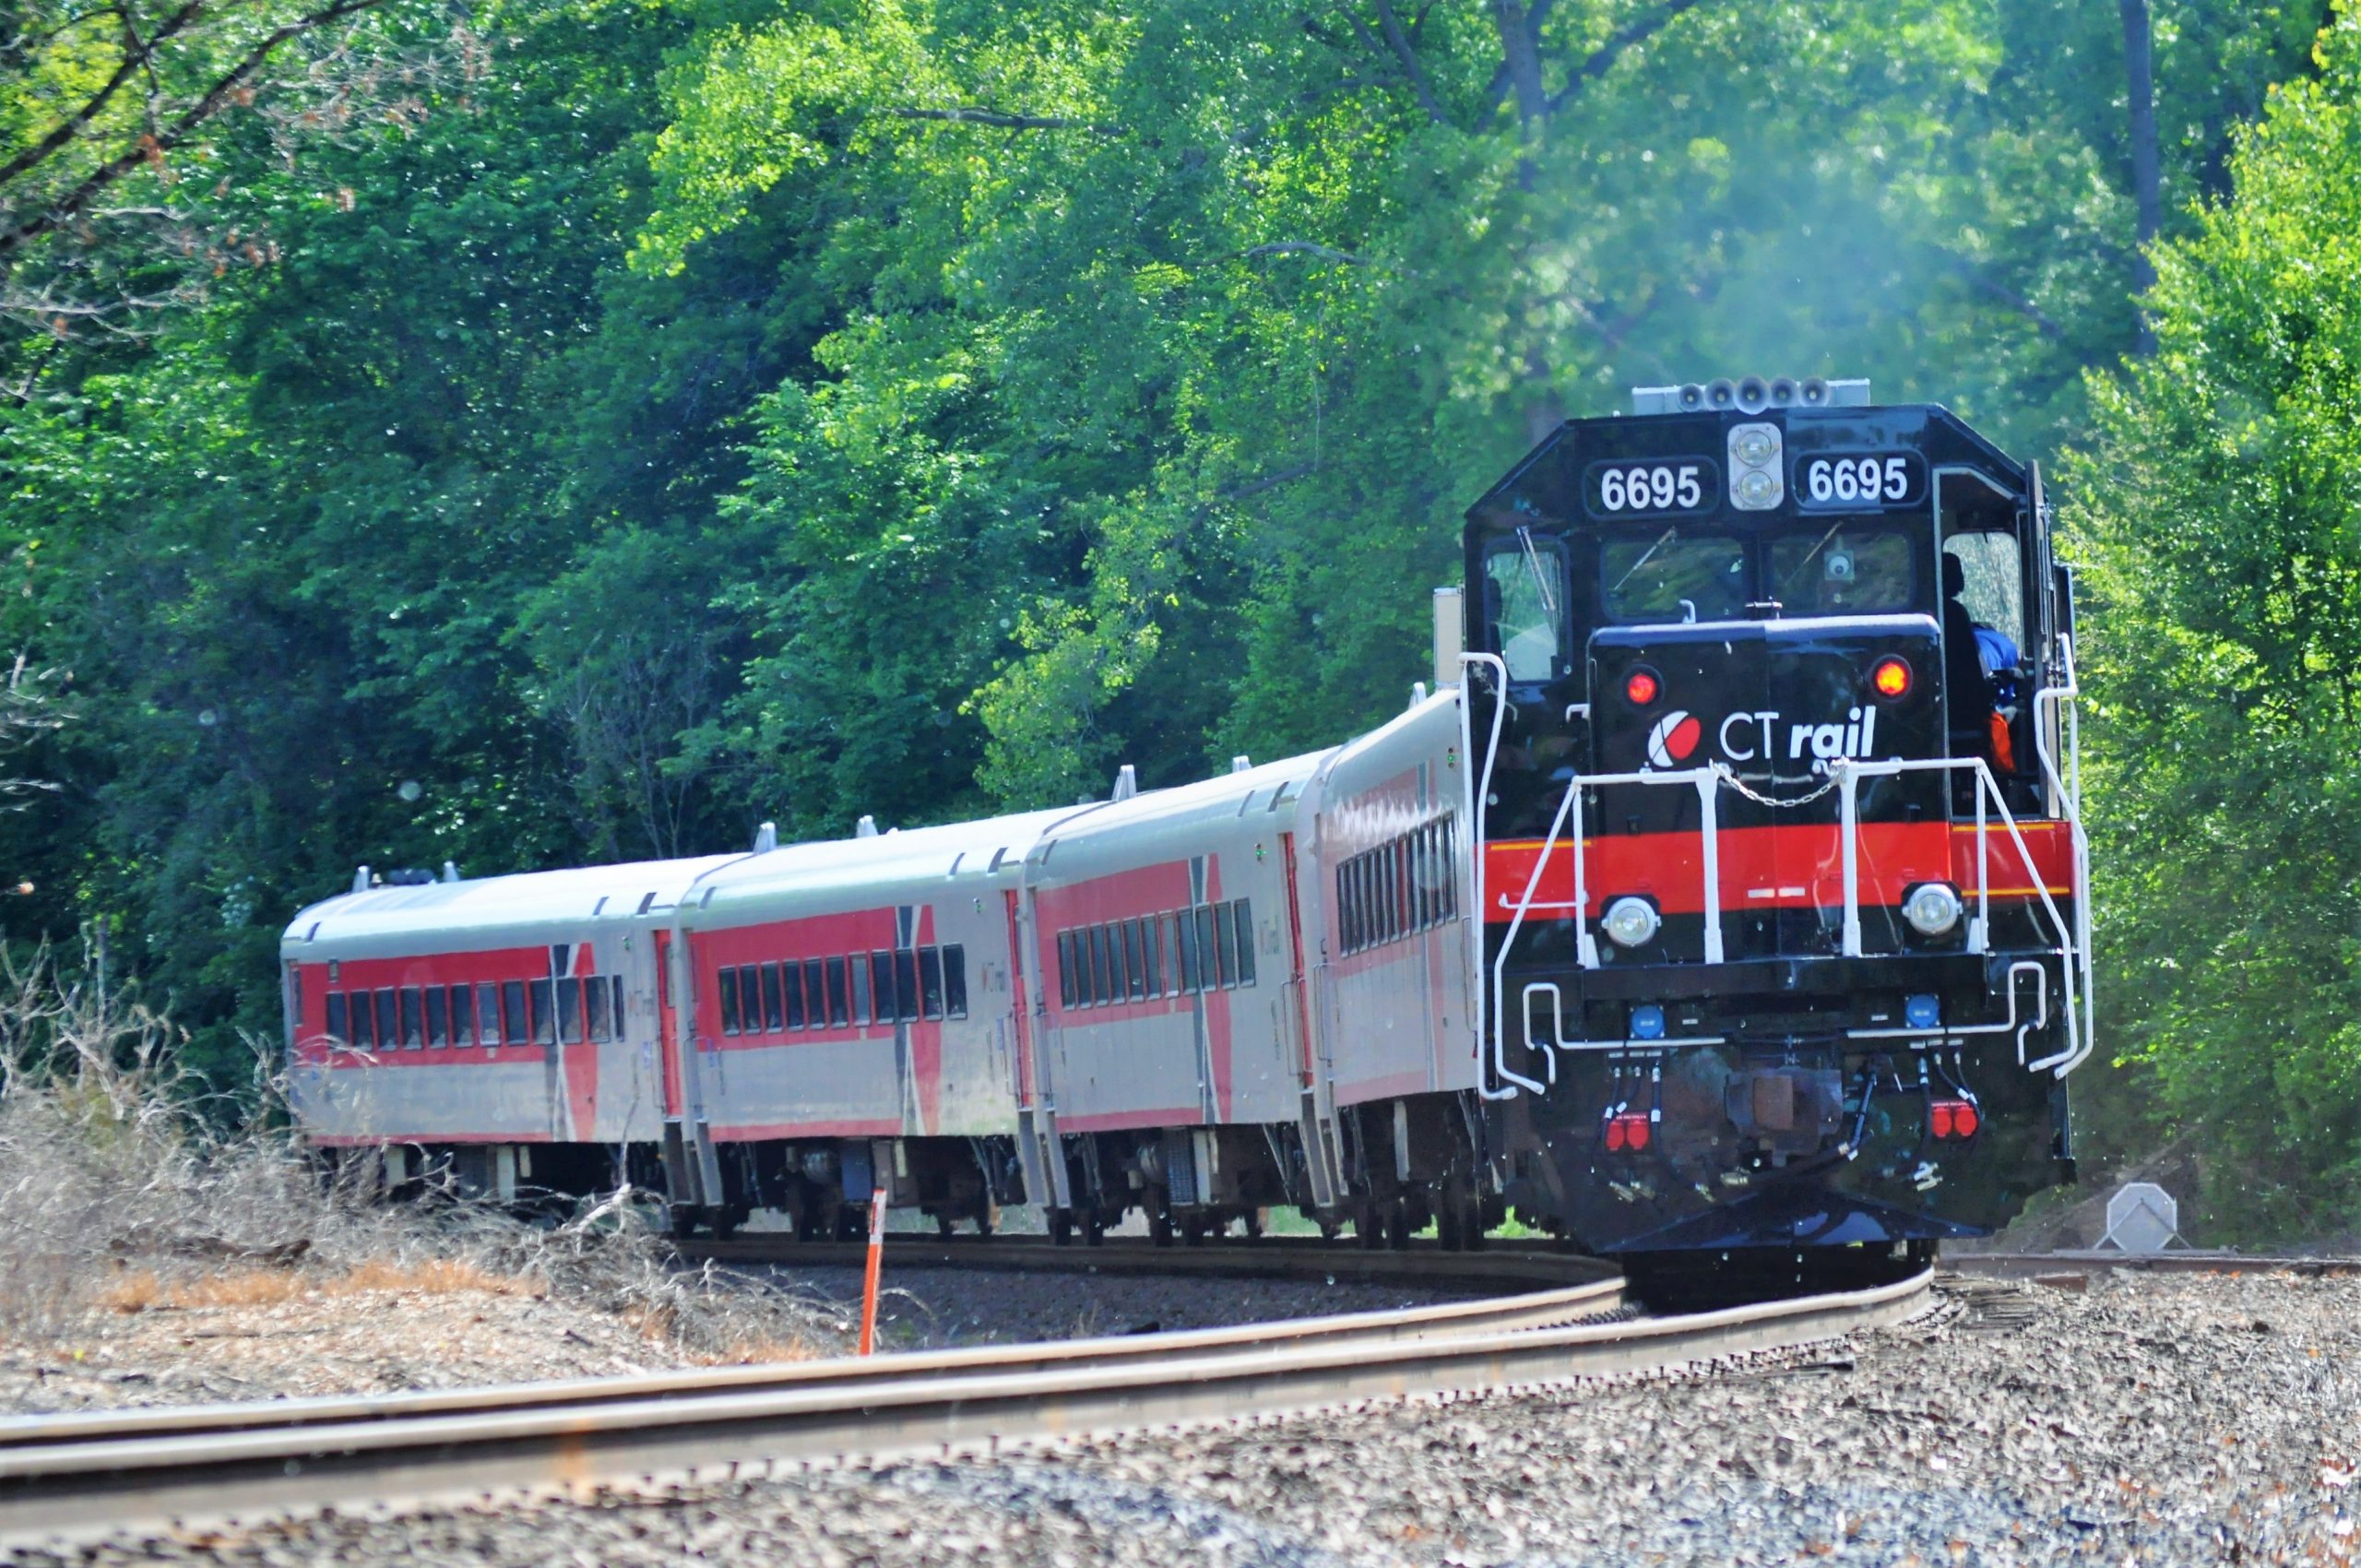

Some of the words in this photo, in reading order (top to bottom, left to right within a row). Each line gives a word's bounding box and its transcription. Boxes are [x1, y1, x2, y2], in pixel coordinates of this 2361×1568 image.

[1601, 466, 1701, 511] 6695
[1809, 457, 1908, 502] 6695
[1719, 710, 1780, 761] CT
[1789, 705, 1877, 759] rail
